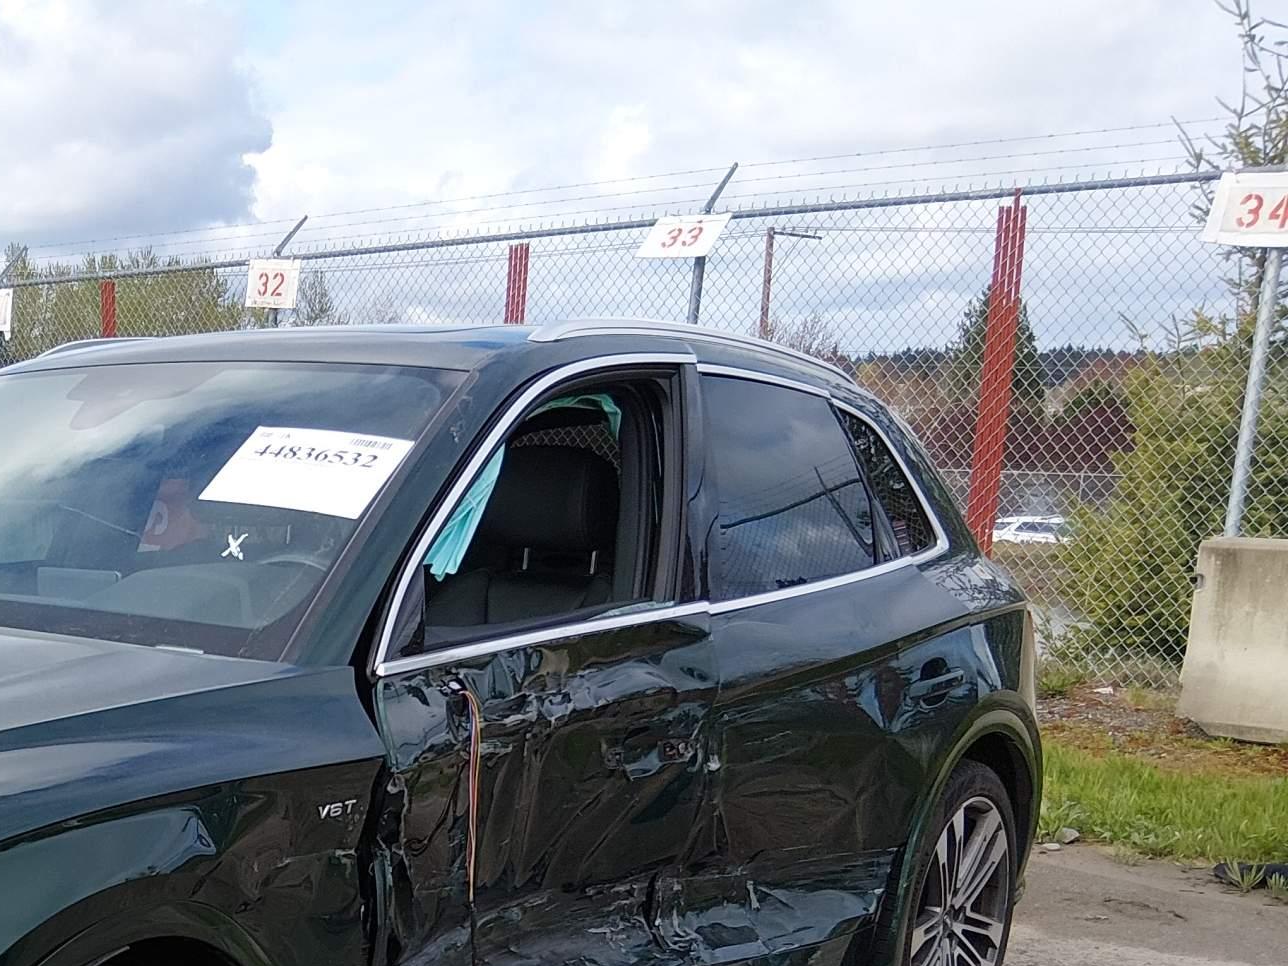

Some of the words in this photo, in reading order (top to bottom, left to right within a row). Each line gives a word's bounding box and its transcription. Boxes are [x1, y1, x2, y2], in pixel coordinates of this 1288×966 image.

[1236, 193, 1288, 229] 34
[661, 226, 703, 248] 33
[257, 271, 285, 297] 32
[254, 443, 379, 468] 44836532
[317, 799, 357, 820] V6T
